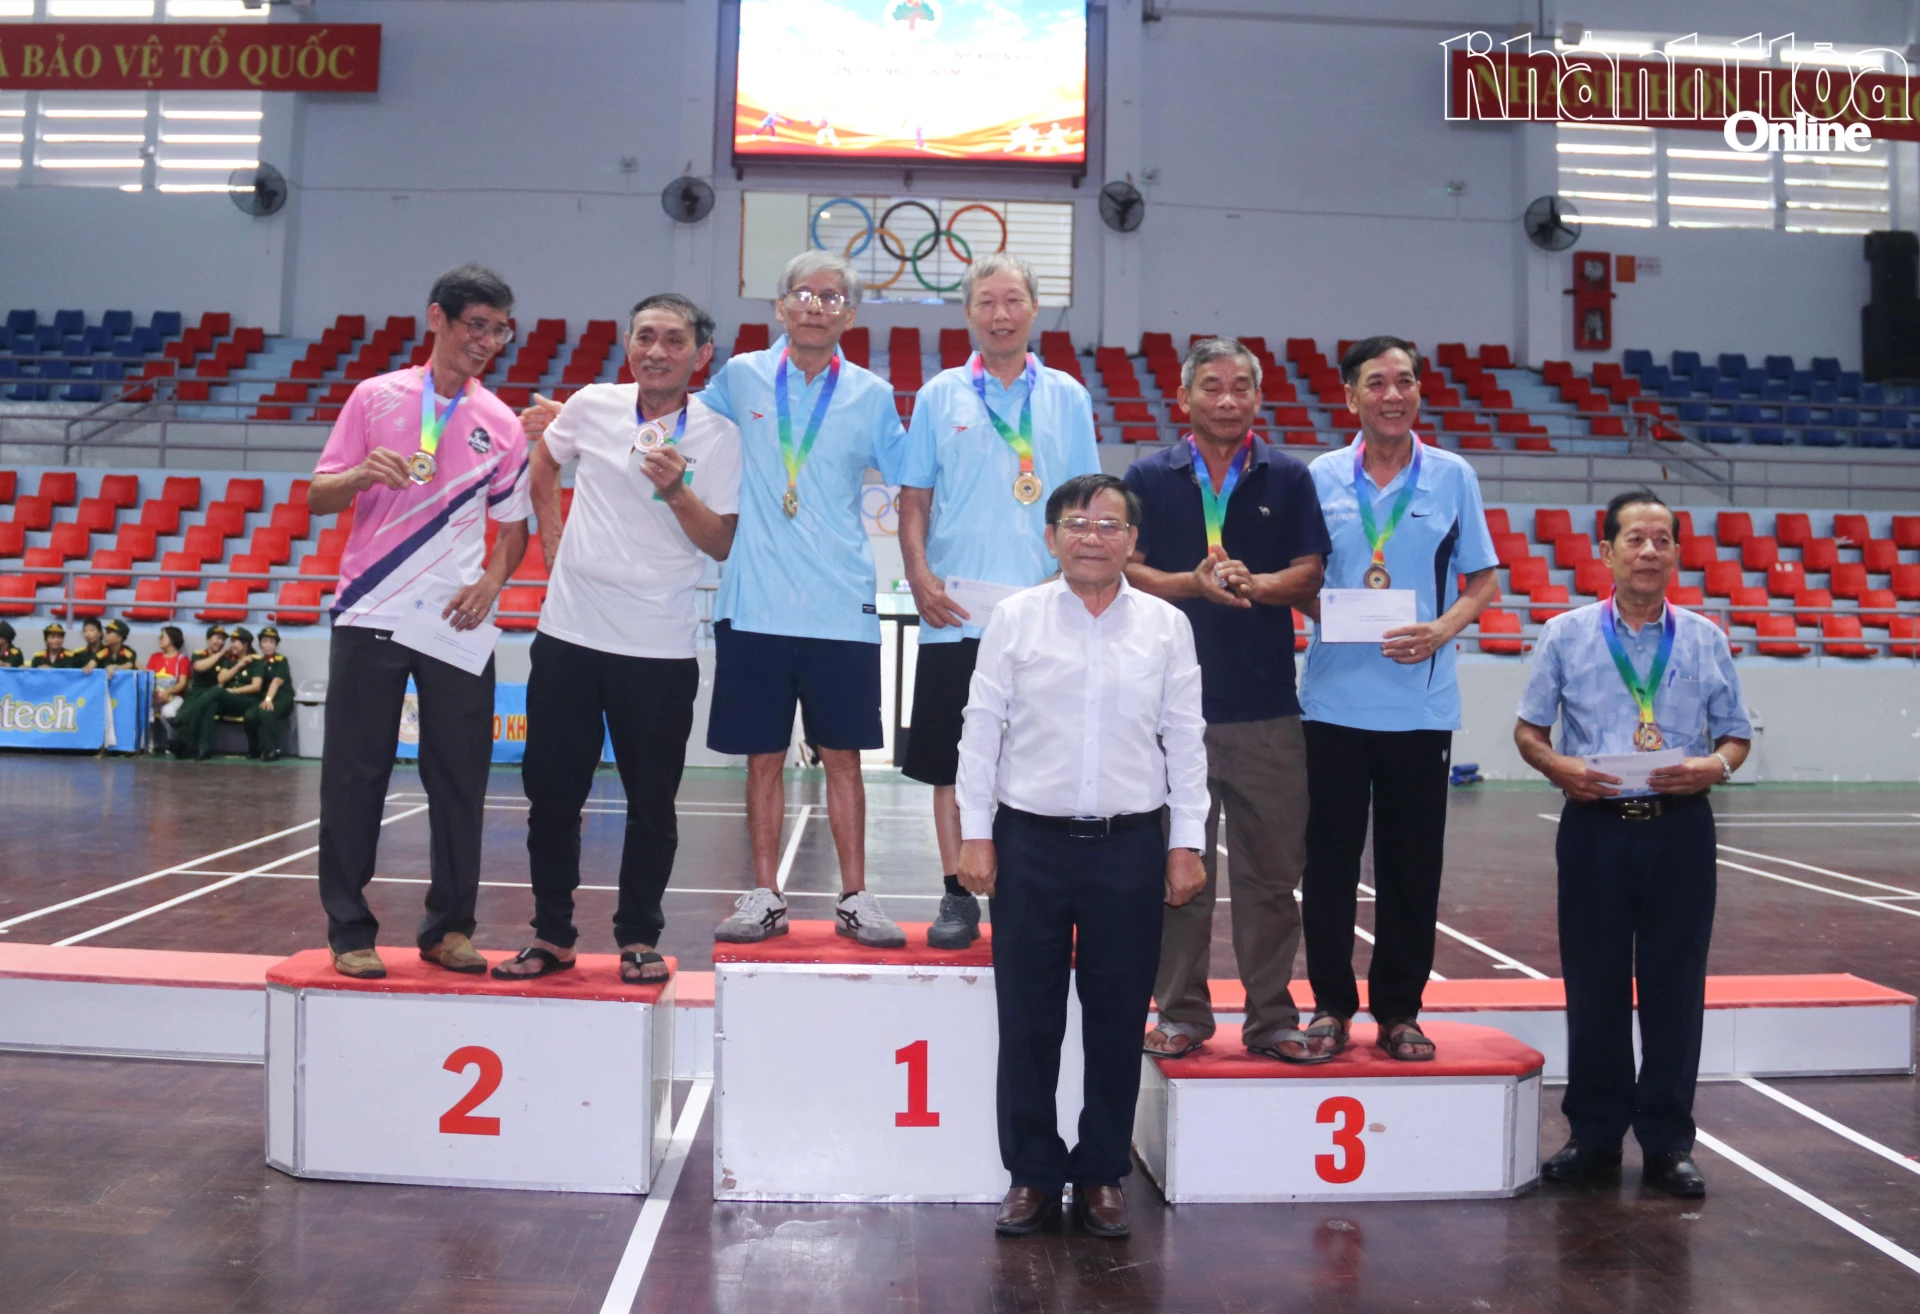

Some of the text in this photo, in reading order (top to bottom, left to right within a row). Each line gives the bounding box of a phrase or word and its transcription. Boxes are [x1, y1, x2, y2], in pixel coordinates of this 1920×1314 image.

[21, 33, 102, 79] BẢO
[113, 34, 164, 87] VỆ
[174, 27, 229, 79] TỔ
[239, 28, 355, 86] QUỐC
[1779, 80, 1869, 122] CAO
[0, 694, 76, 731] tech
[439, 1046, 504, 1137] 2
[895, 1040, 940, 1127] 1
[1314, 1096, 1366, 1184] 3
